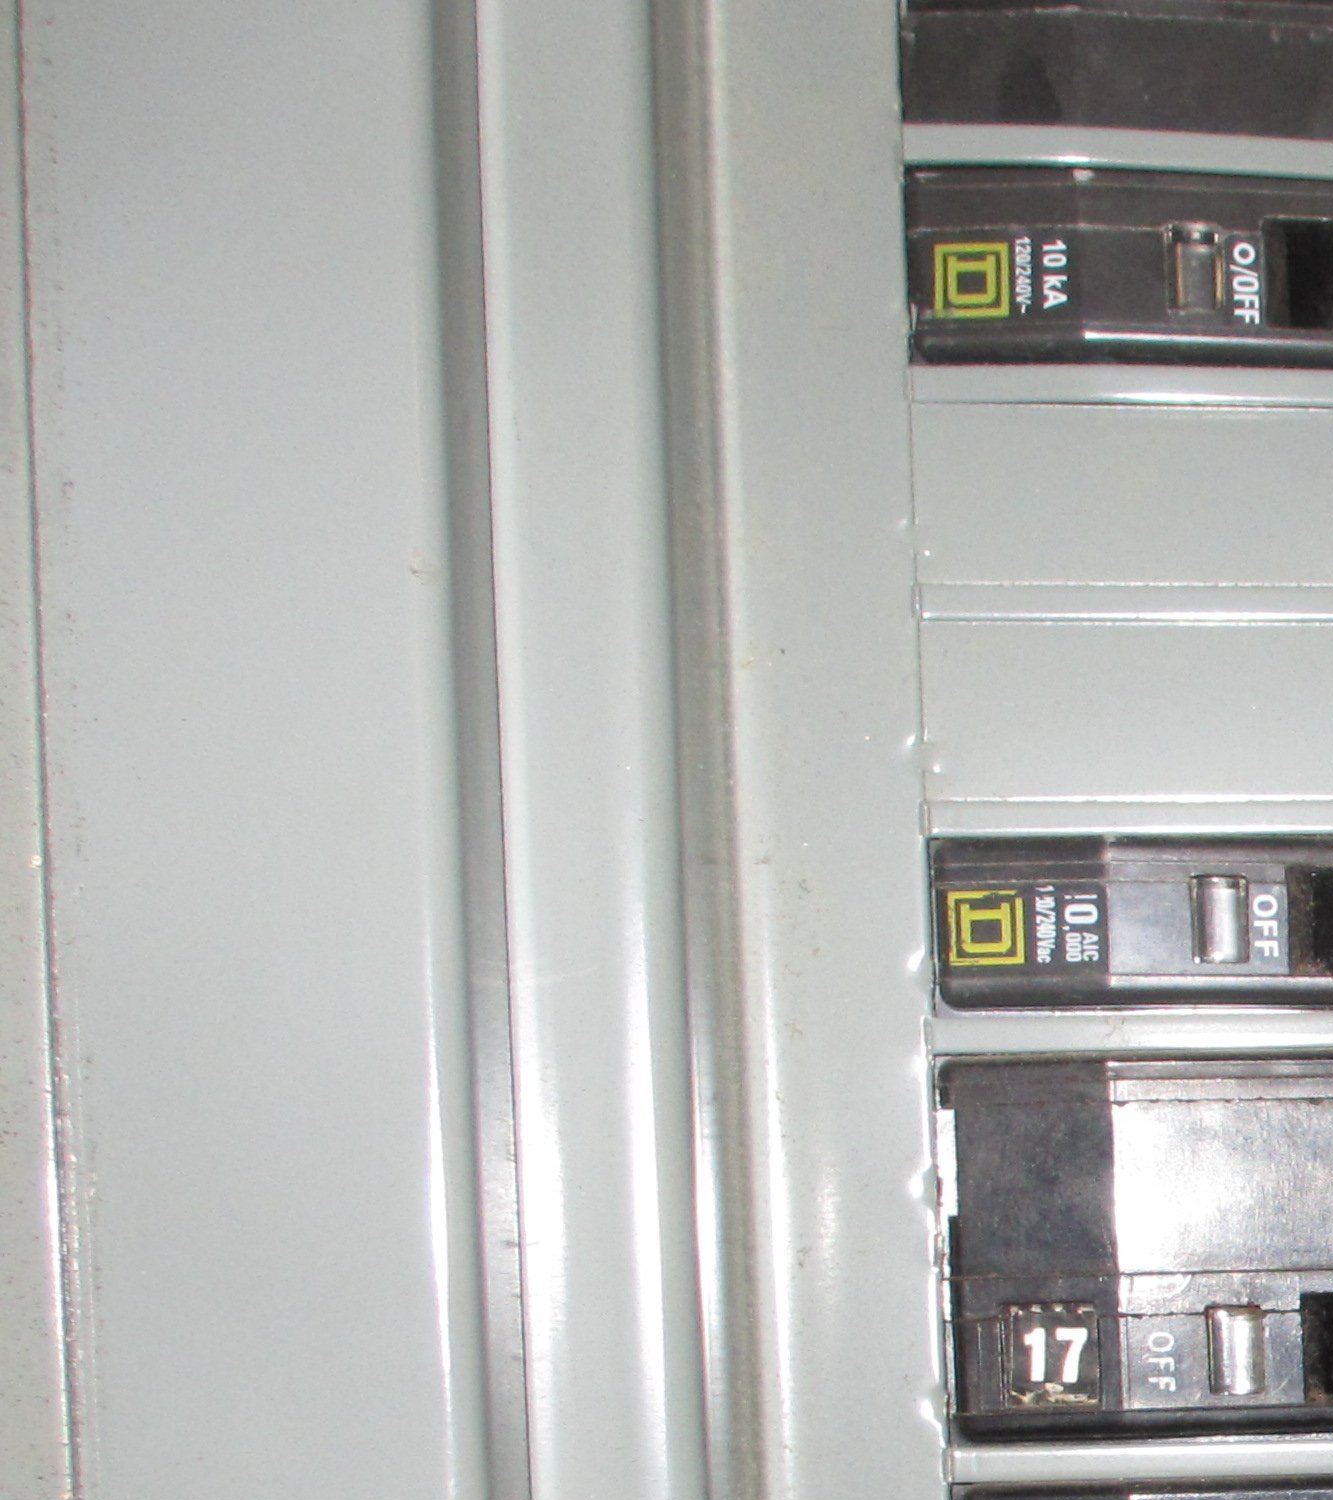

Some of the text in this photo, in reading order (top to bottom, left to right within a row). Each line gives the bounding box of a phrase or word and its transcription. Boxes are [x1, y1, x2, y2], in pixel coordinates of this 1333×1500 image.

[1042, 239, 1069, 310] 10 kA
[1230, 241, 1261, 325] O/OFF
[1082, 931, 1100, 963] AIC
[1253, 893, 1280, 959] OFF
[1023, 1326, 1089, 1386] 17
[1147, 1331, 1177, 1393] OFF
